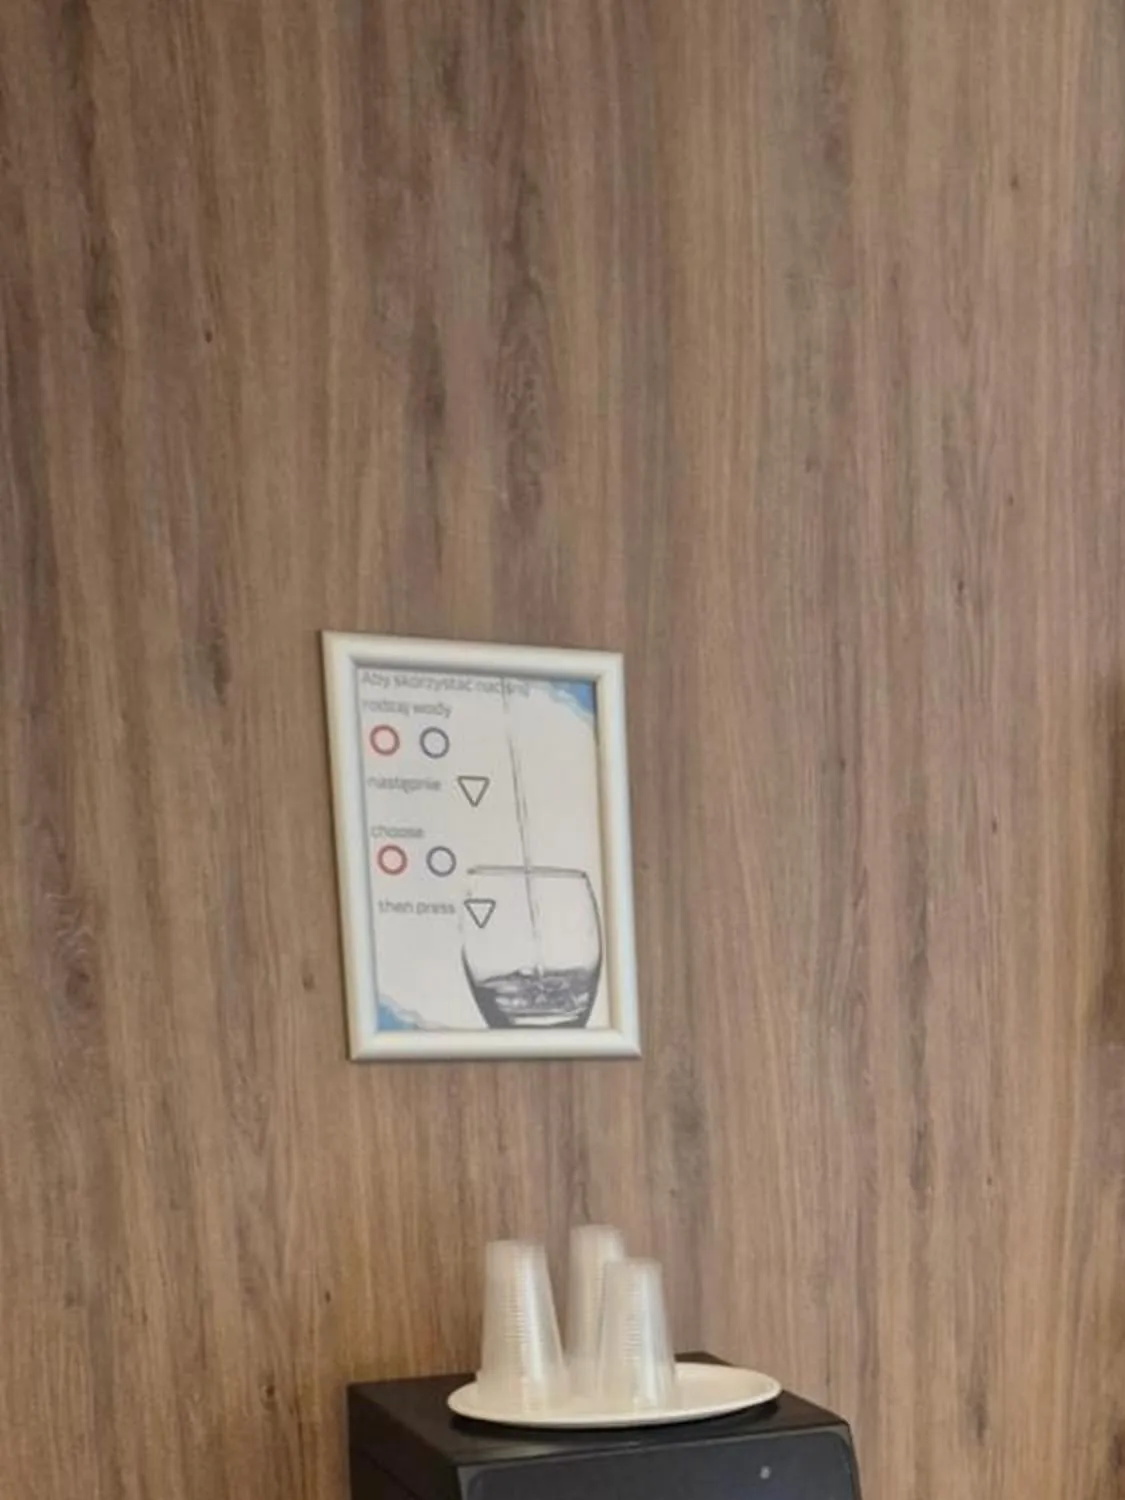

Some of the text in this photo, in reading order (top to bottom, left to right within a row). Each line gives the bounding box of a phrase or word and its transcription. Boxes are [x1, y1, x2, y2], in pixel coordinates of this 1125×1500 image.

[361, 672, 390, 688] Aby
[371, 825, 424, 839] choose
[378, 898, 456, 915] then press
